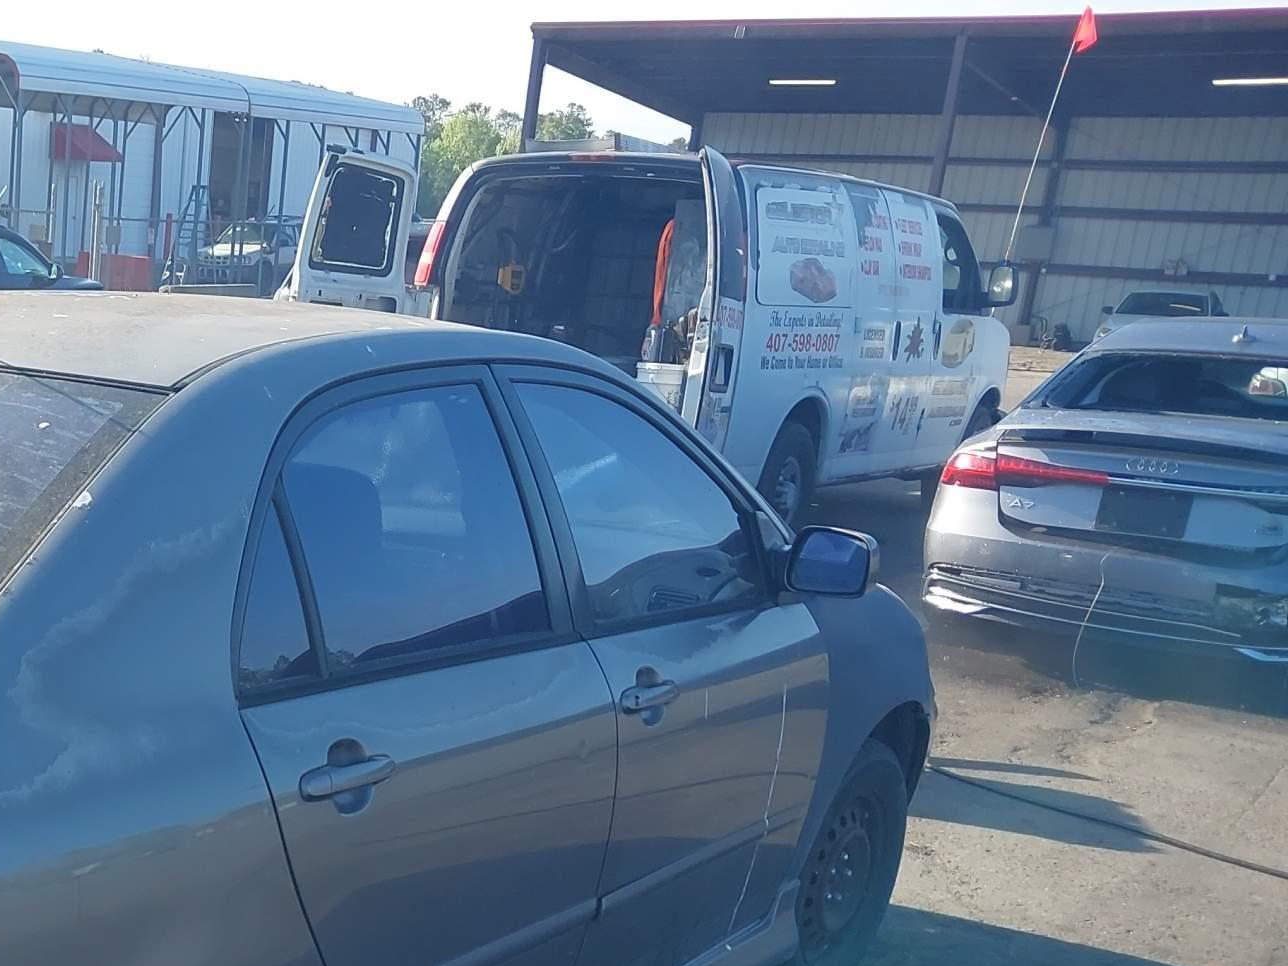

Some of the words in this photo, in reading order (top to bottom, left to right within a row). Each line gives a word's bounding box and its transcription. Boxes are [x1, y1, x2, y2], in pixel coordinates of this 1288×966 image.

[770, 310, 782, 327] The
[783, 310, 807, 331] Experts
[766, 333, 841, 353] 407-598-0807
[760, 355, 769, 370] We
[770, 355, 786, 370] Come
[787, 356, 793, 369] to
[1008, 497, 1034, 508] A7
